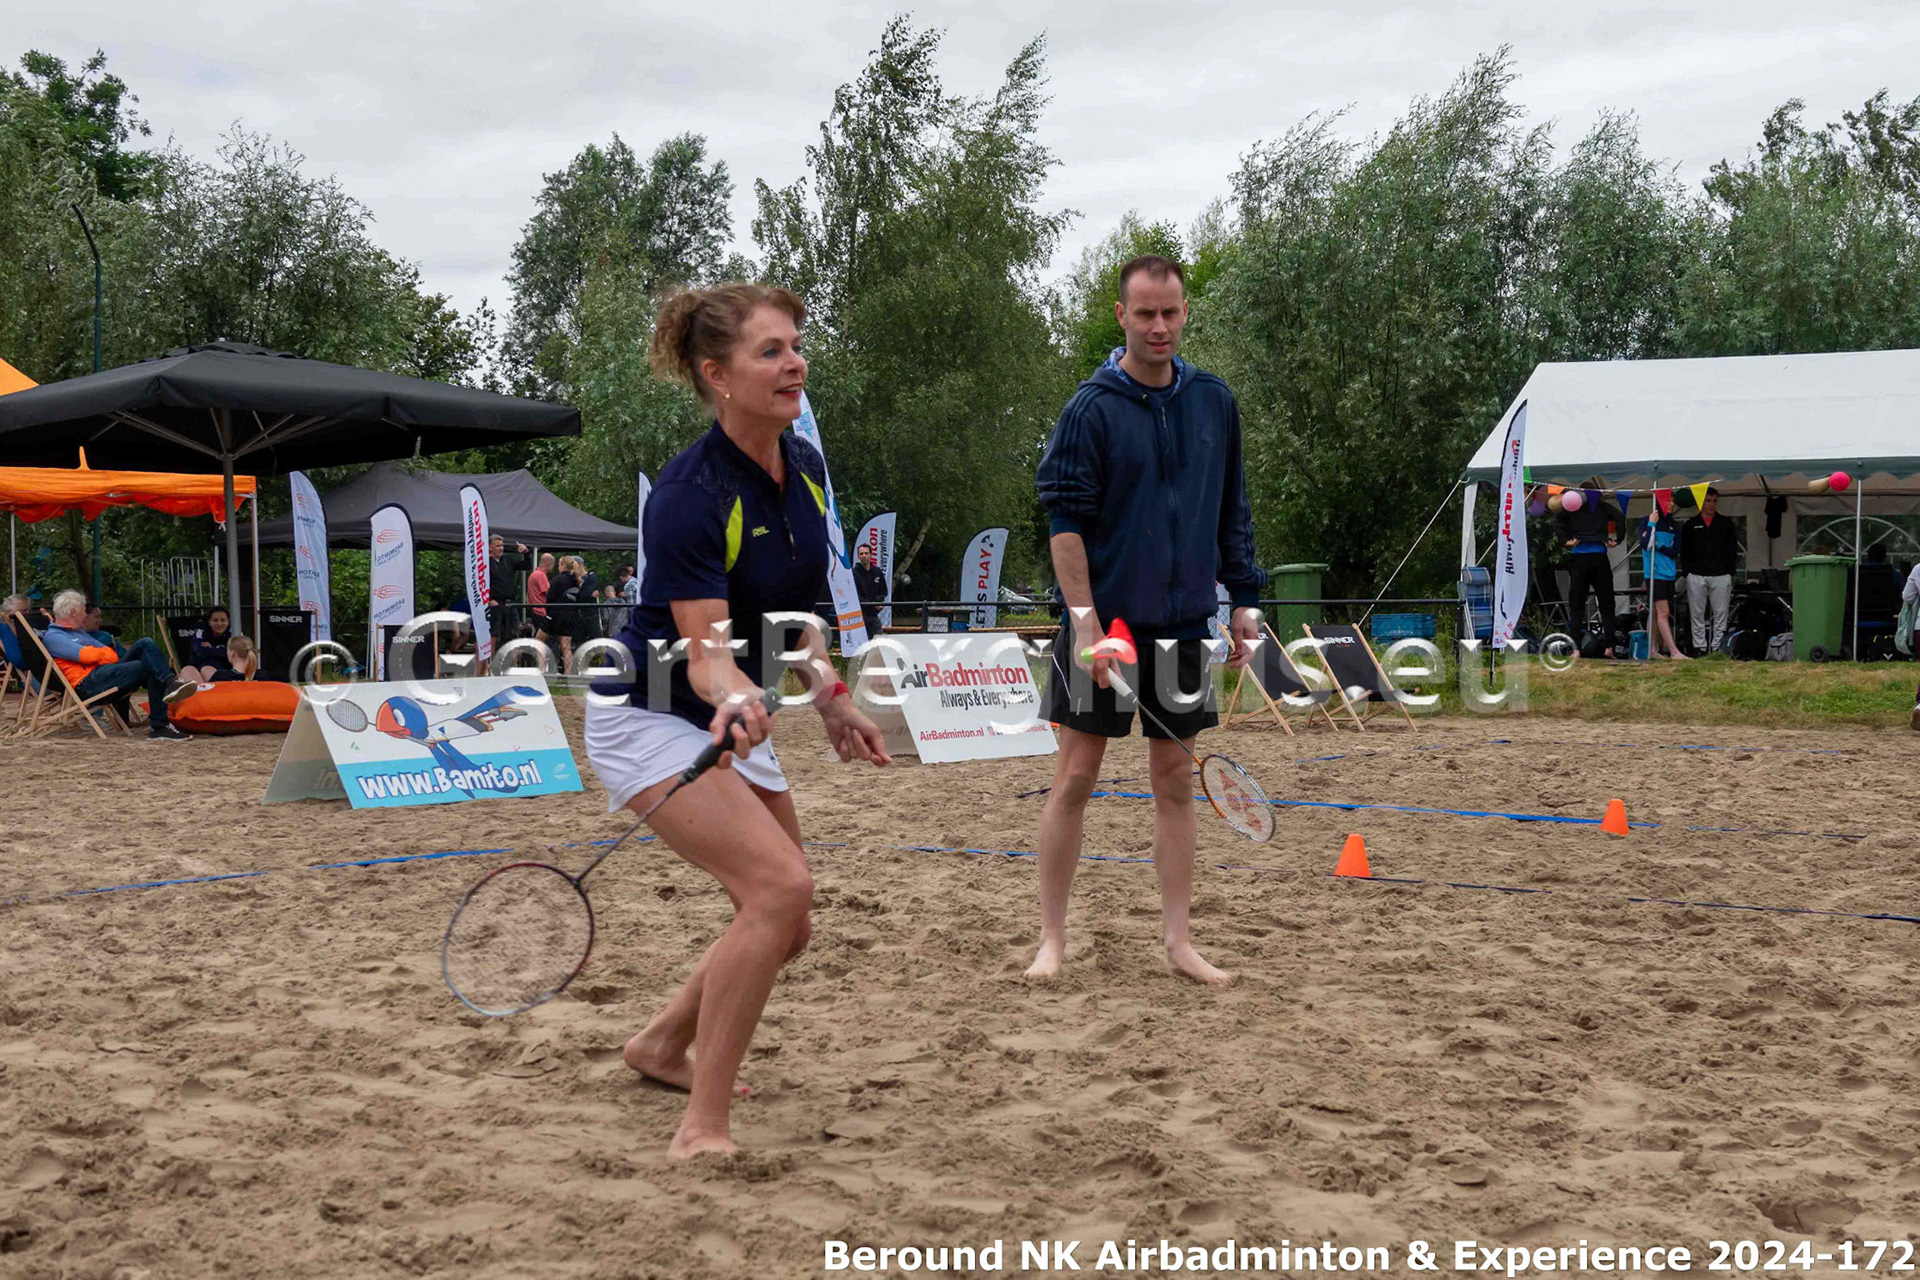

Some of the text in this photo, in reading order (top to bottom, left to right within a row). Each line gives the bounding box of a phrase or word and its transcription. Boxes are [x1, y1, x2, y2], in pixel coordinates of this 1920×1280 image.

[977, 548, 993, 590] PLAY
[269, 614, 303, 624] SINNER
[391, 635, 426, 644] SINNER
[1323, 636, 1356, 645] SINNER
[897, 658, 1029, 689] AirBadminton
[939, 689, 974, 711] Always
[919, 726, 984, 741] AirBadminton.nl
[355, 758, 543, 801] www.Bamito.nl
